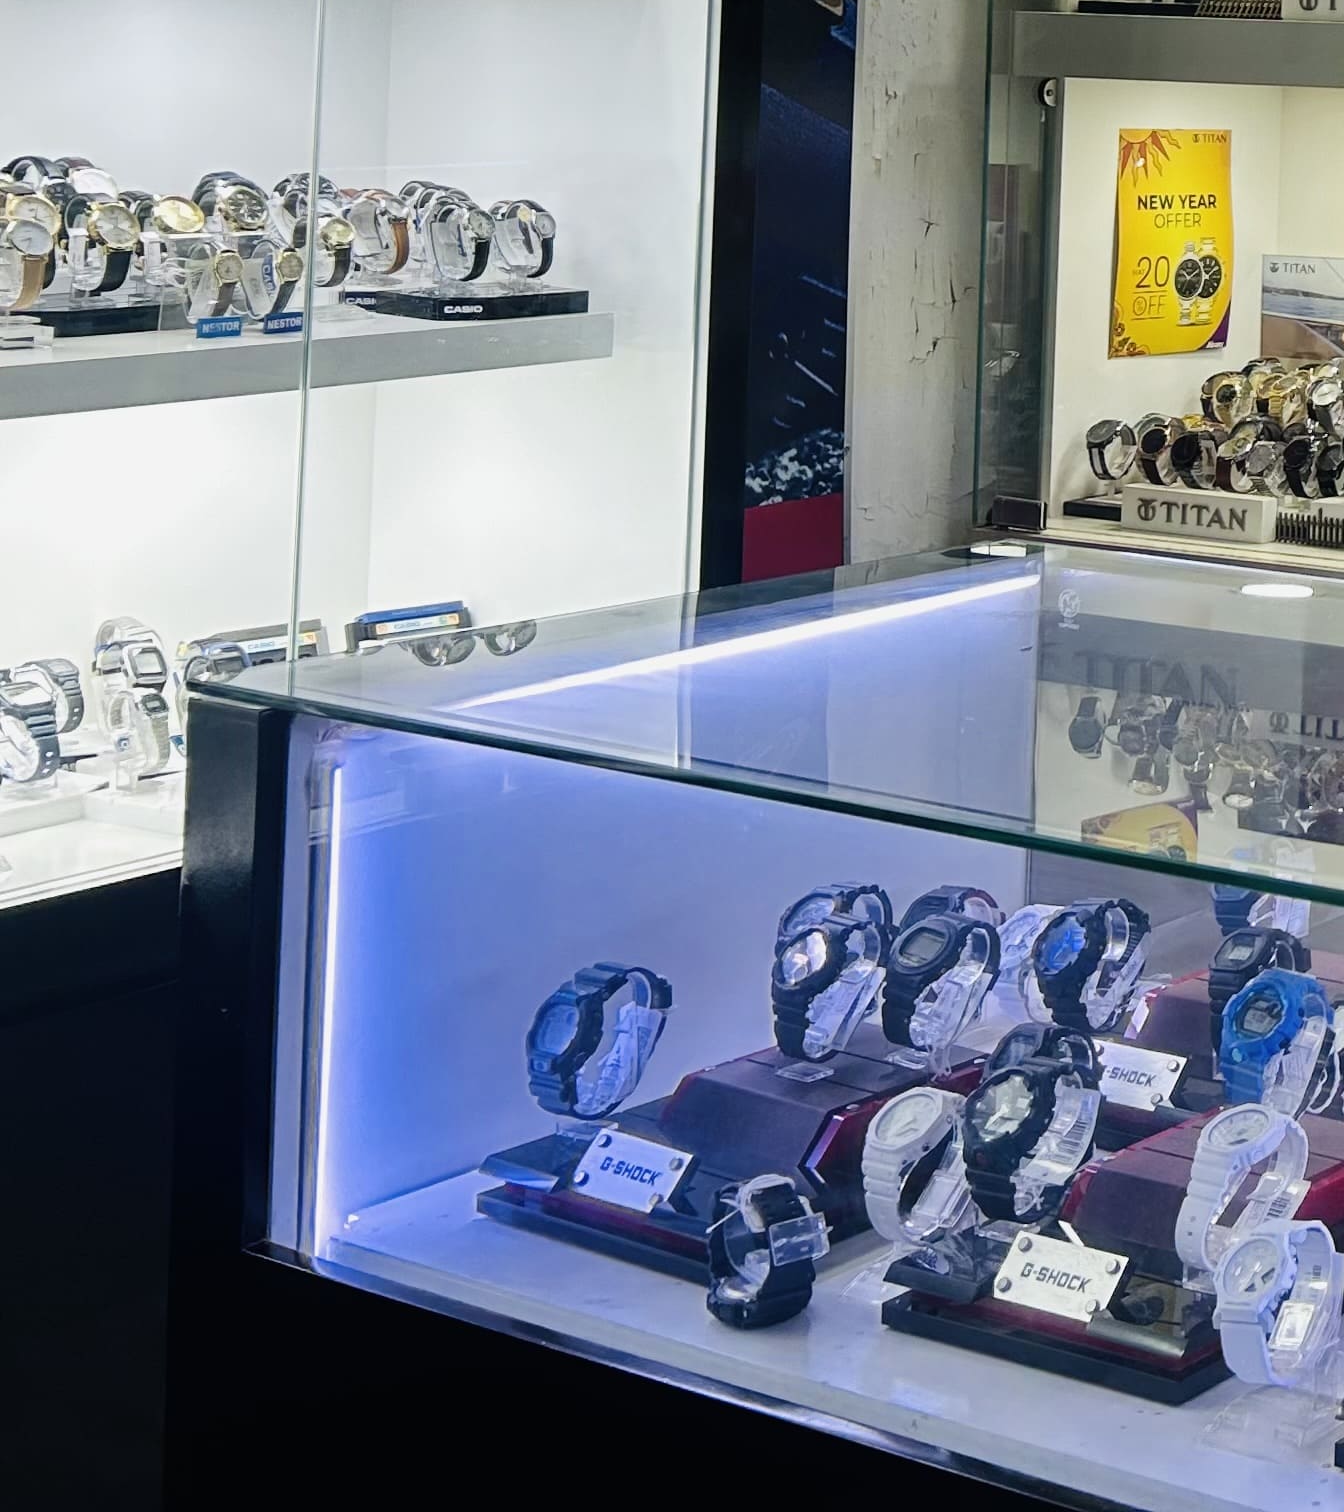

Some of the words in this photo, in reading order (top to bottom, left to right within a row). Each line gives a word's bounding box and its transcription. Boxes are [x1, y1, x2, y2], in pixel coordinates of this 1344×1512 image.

[1202, 133, 1227, 144] TITAN
[1137, 194, 1175, 211] NEW
[1179, 194, 1217, 210] YEAR
[1154, 213, 1202, 229] OFFER
[1137, 256, 1170, 288] 20
[1283, 262, 1316, 275] TITAN
[444, 305, 483, 314] CASIO
[202, 321, 240, 333] NESTOR
[267, 317, 303, 330] NESTOR
[1160, 501, 1248, 533] TITAN
[1102, 1064, 1158, 1088] -SHOCK
[600, 1158, 661, 1187] G-SHOCK
[1020, 1261, 1092, 1294] G-SHOCK
